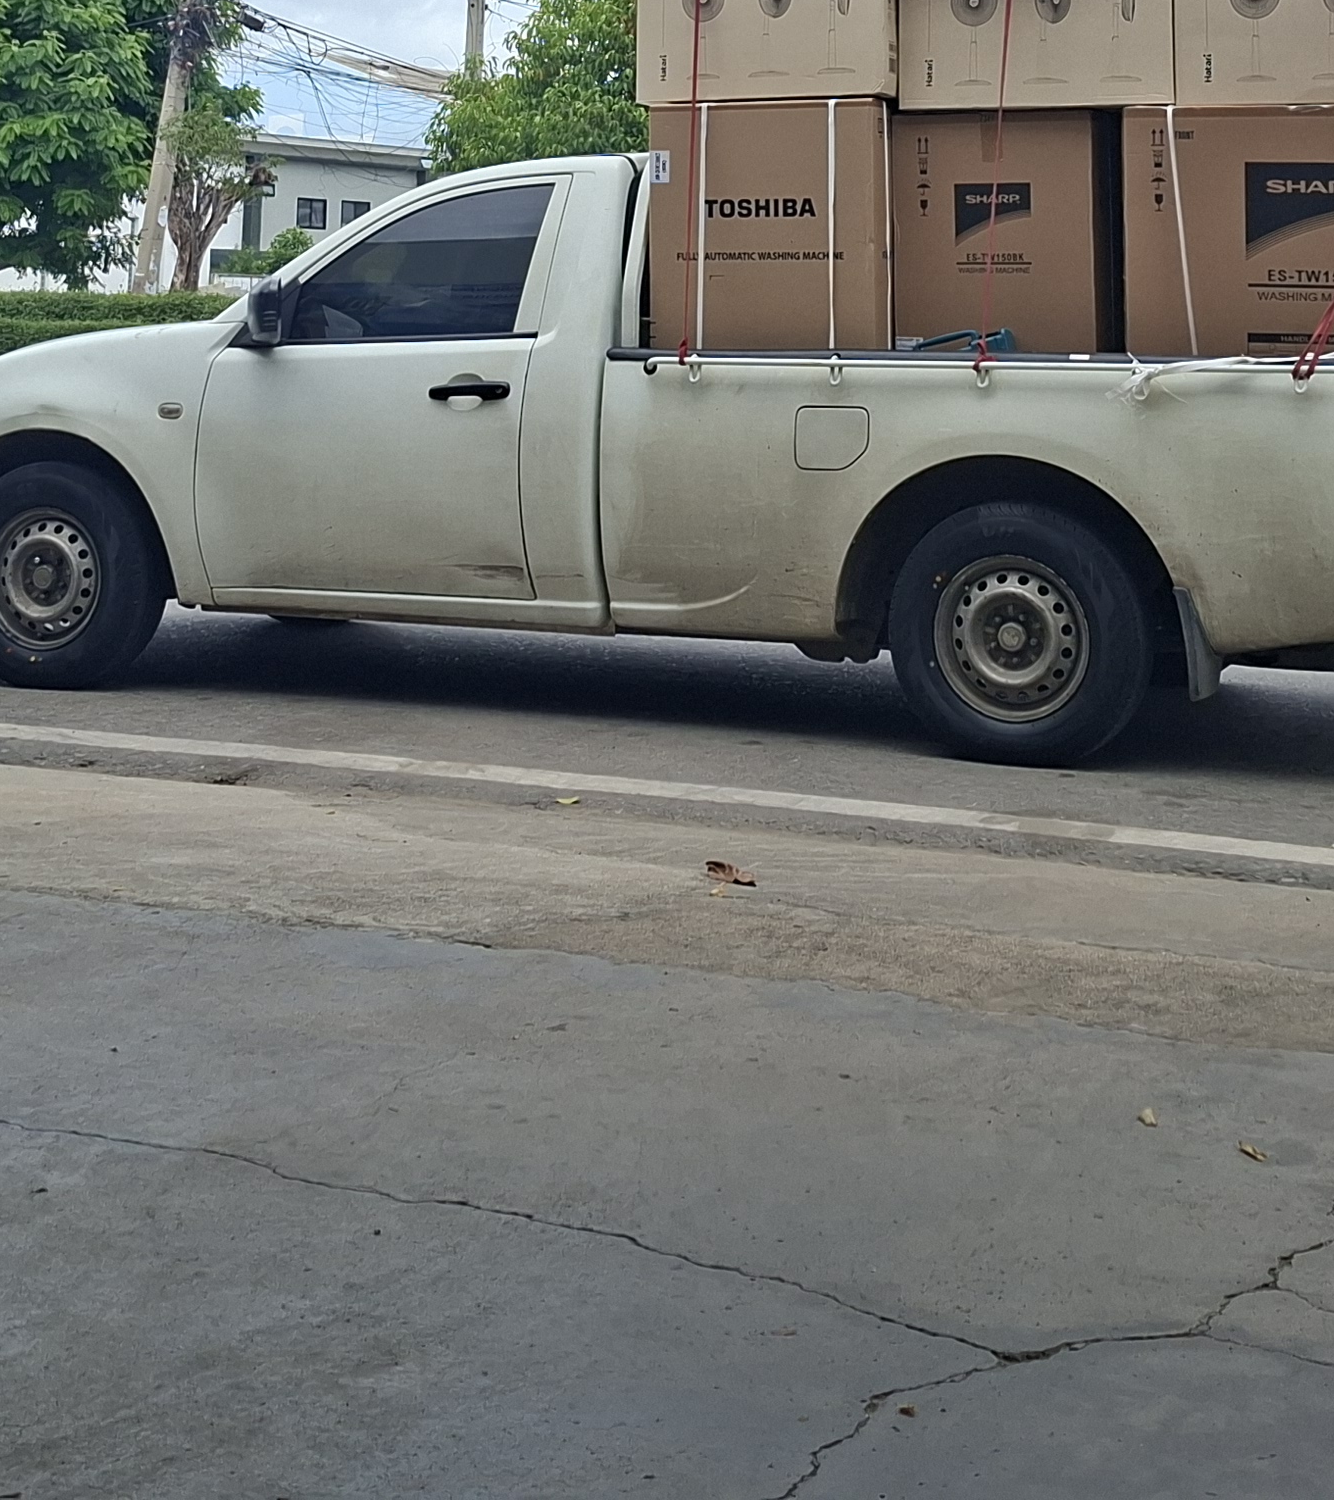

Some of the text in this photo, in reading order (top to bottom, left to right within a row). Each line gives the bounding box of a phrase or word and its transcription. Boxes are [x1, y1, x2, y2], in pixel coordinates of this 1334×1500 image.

[660, 55, 668, 81] Hatari
[925, 58, 934, 87] Hatari
[1203, 53, 1212, 83] Hatari
[704, 198, 817, 219] TOSHIBA
[965, 194, 1020, 204] SHARP
[704, 252, 756, 261] AUTOMATIC
[758, 252, 801, 261] WASHING
[803, 252, 844, 261] MACHNE
[1257, 291, 1318, 302] WASHING
